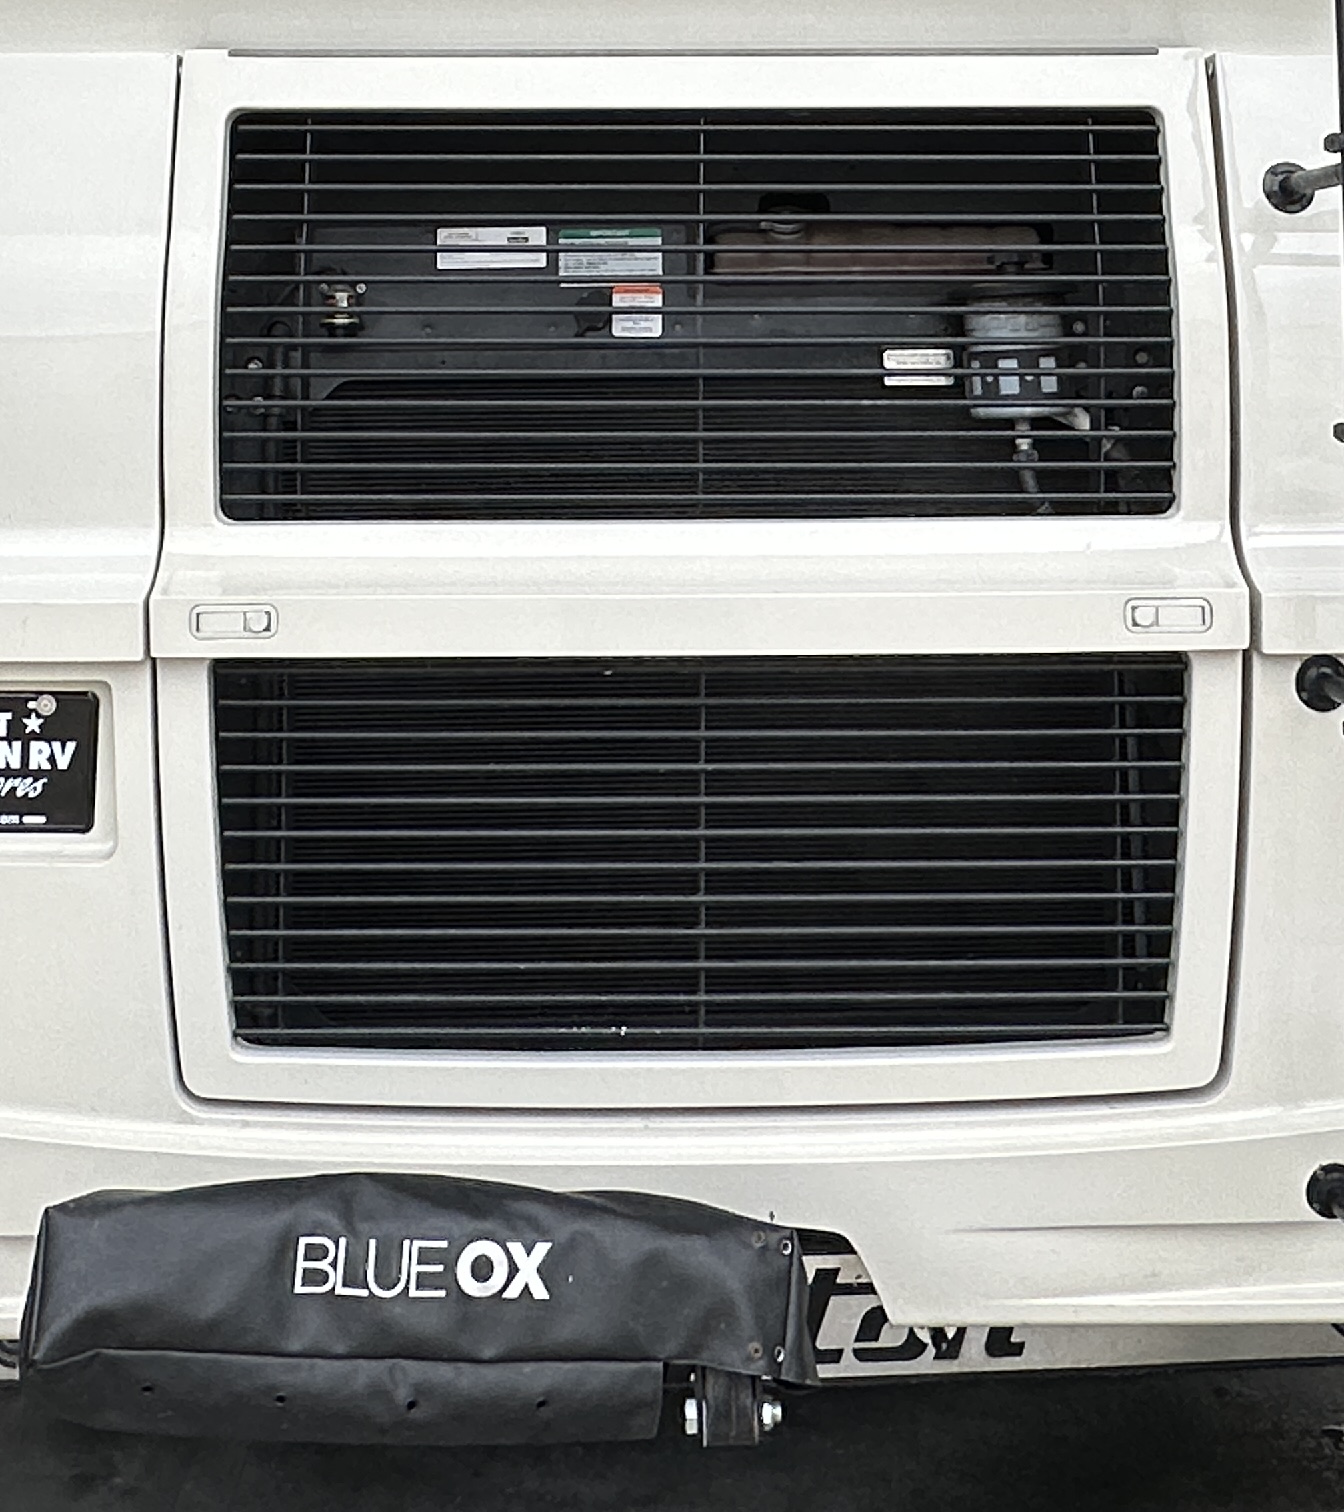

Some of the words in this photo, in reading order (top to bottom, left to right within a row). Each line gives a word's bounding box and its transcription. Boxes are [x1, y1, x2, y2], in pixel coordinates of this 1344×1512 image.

[28, 740, 77, 770] RV
[293, 1235, 449, 1299] BLUE
[455, 1239, 553, 1300] OX
